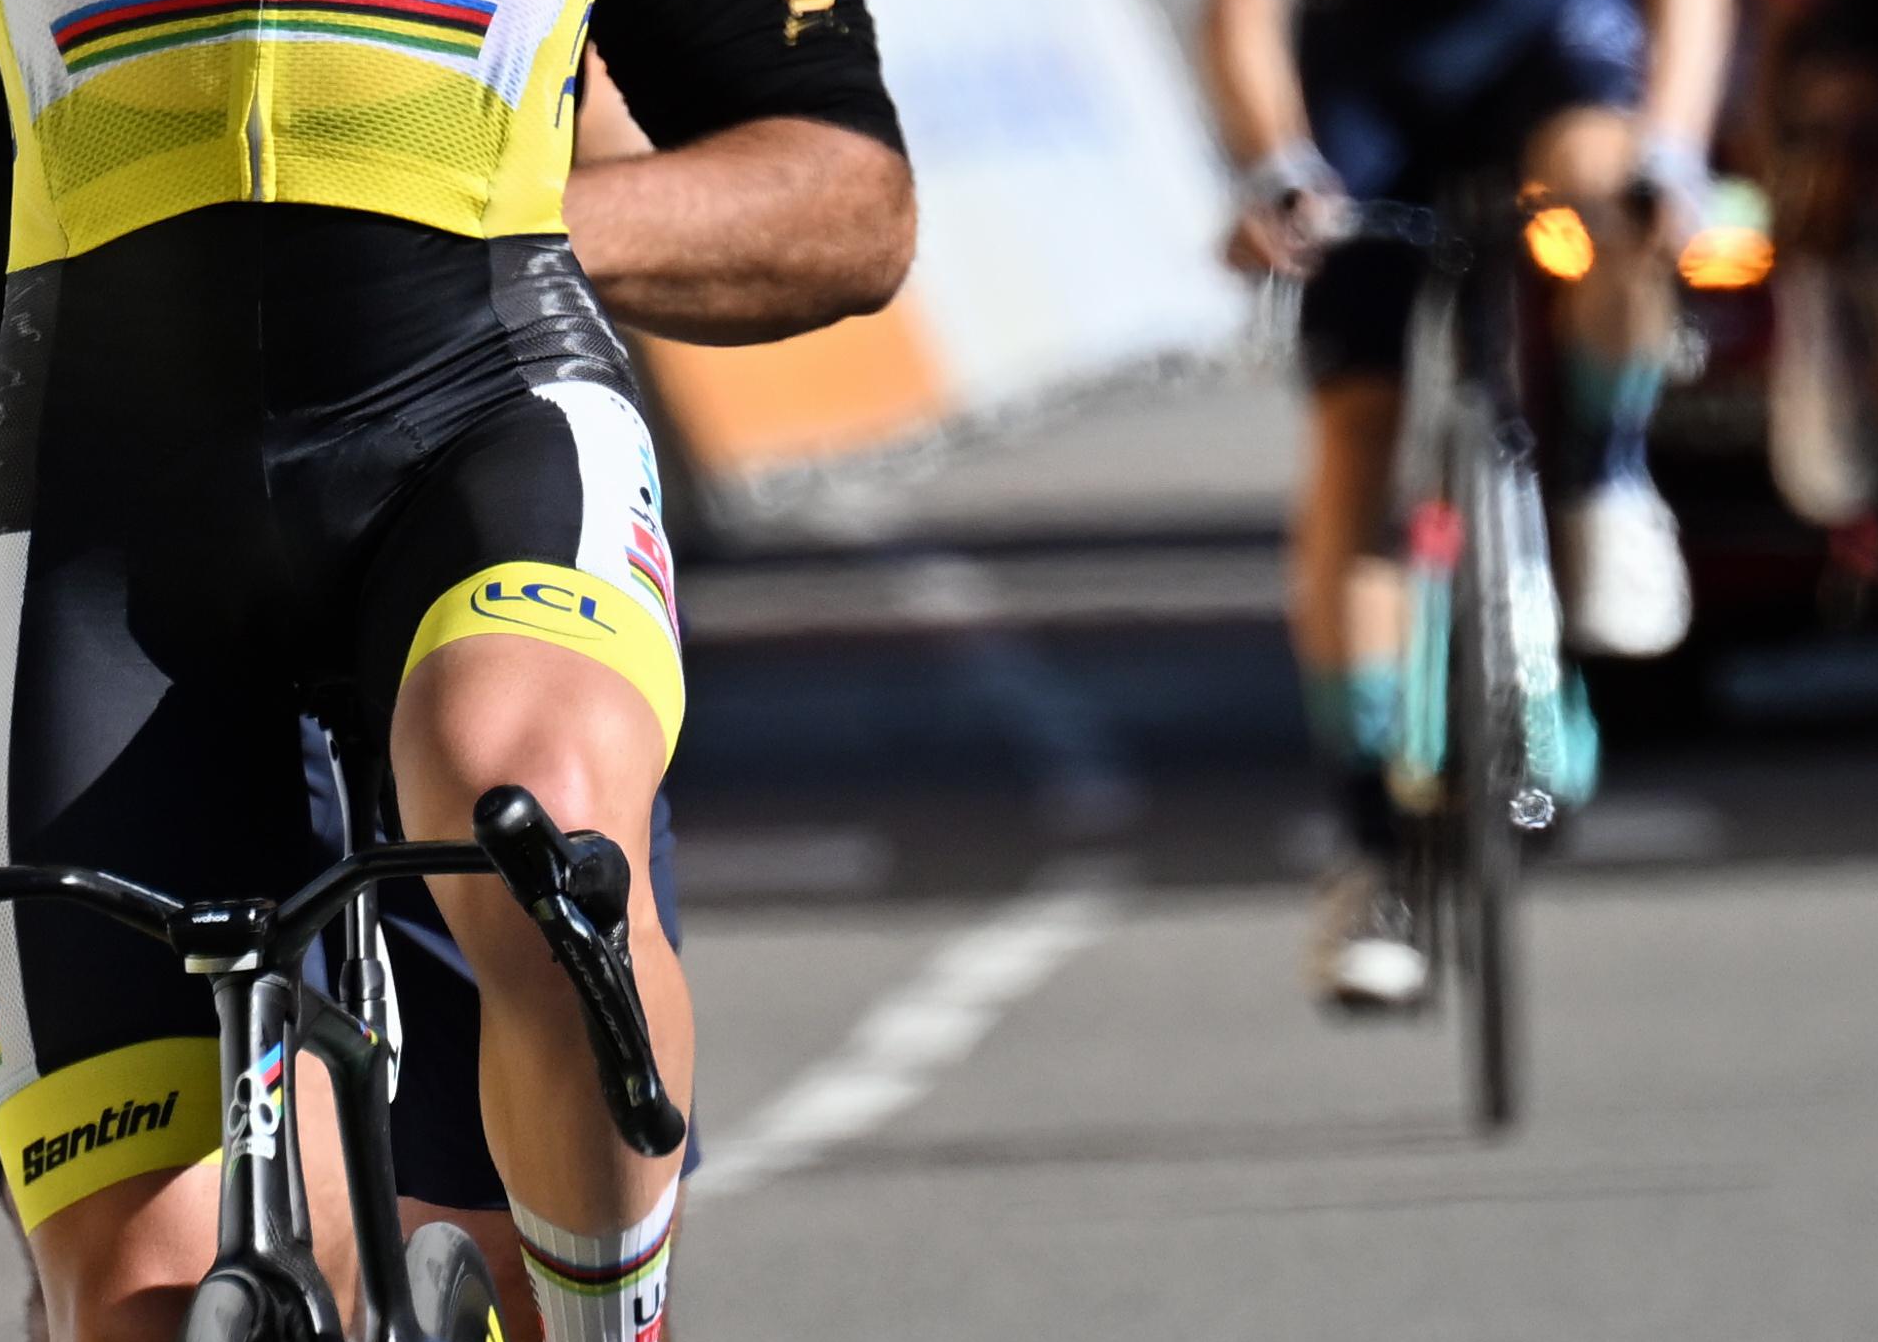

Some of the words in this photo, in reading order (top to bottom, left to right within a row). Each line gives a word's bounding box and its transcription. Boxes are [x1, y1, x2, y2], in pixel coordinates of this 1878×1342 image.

[484, 581, 616, 635] LCL
[191, 908, 231, 924] wahoo
[22, 1089, 179, 1188] Santini
